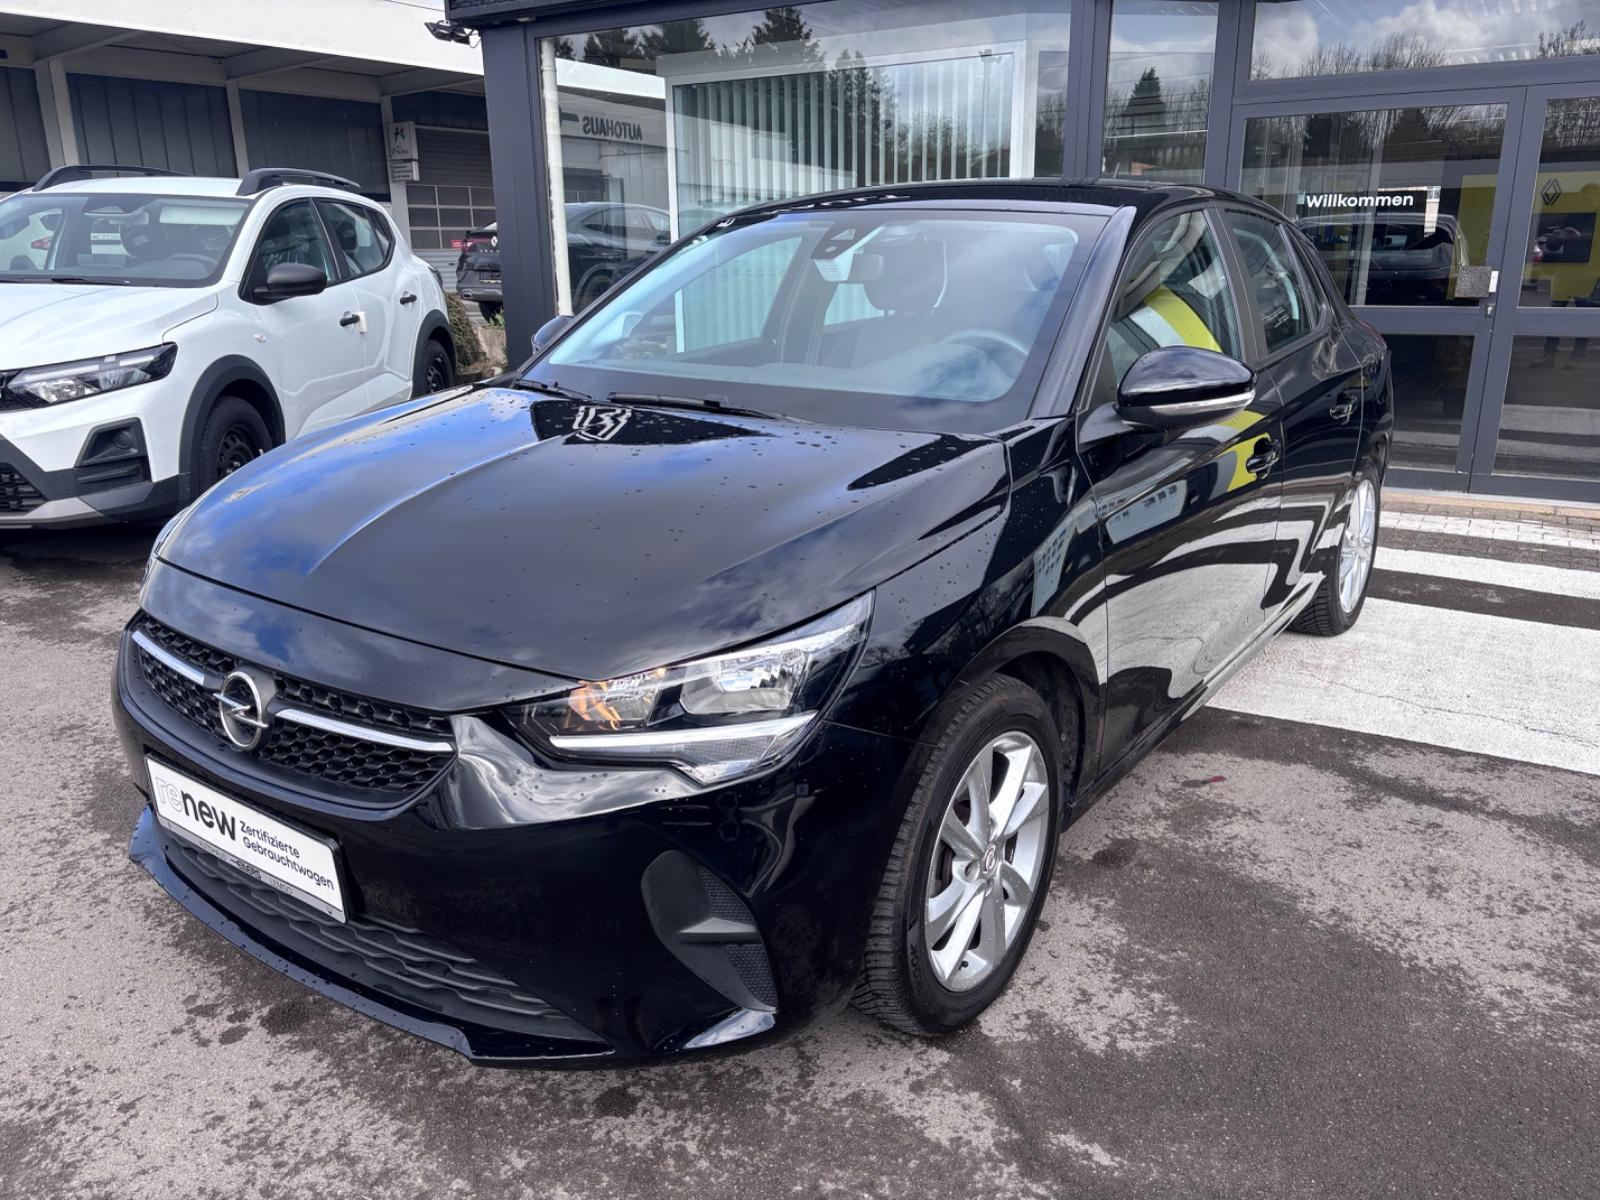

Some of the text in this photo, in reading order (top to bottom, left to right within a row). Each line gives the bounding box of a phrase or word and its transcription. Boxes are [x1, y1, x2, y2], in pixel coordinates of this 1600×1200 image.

[1306, 193, 1414, 208] Willkommen
[155, 776, 236, 841] renew
[240, 820, 300, 859] Zertifizierte
[243, 836, 335, 891] Gebrauchtwagen
